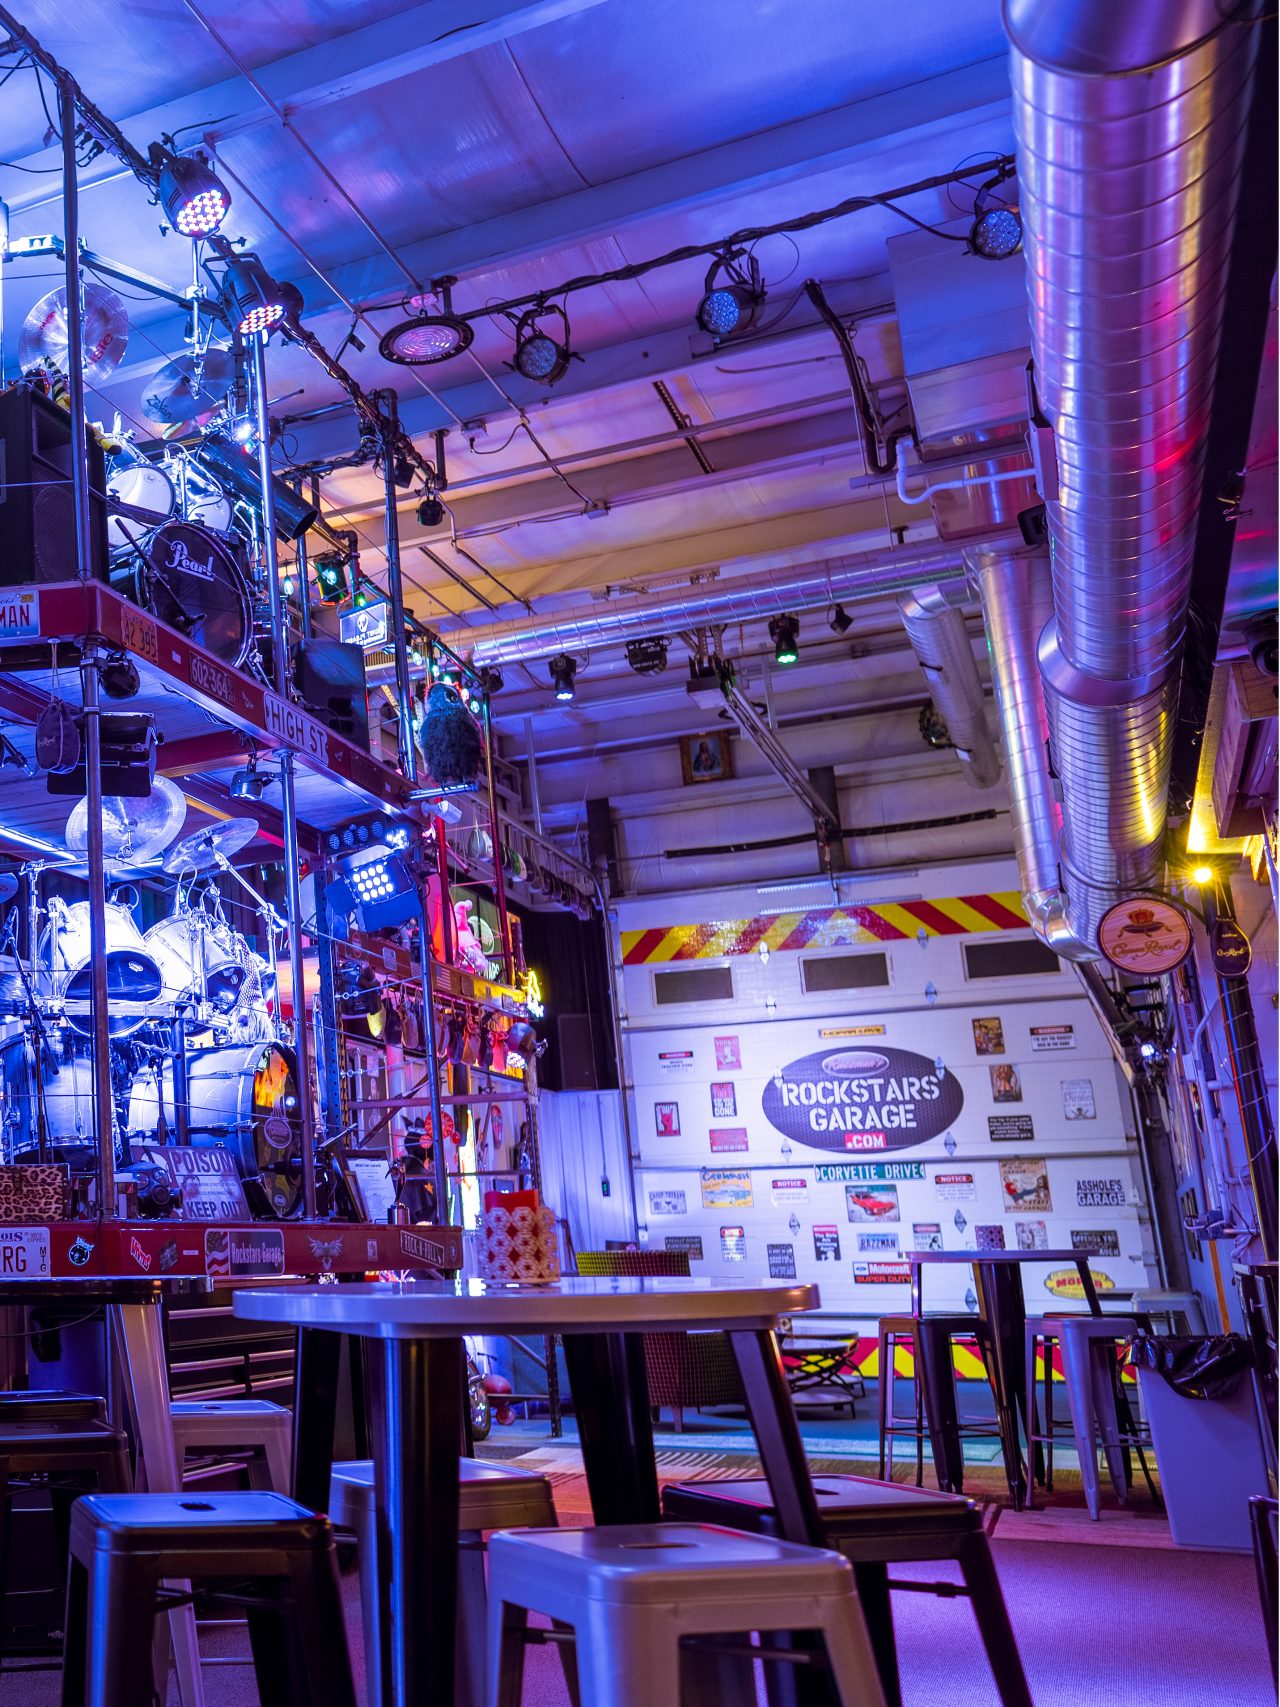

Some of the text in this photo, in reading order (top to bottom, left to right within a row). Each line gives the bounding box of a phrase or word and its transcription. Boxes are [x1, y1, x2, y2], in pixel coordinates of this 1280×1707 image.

[165, 540, 215, 581] Pearl
[192, 658, 228, 699] 602-364
[271, 700, 324, 757] HIGH ST
[782, 1075, 940, 1107] ROCKSTARS
[809, 1104, 917, 1131] GARAGE
[846, 1134, 884, 1148] .COM
[171, 1151, 234, 1173] POISON
[821, 1163, 920, 1181] CORVETTE DRIVE
[940, 1175, 967, 1183] NOTICE
[1077, 1179, 1123, 1192] ASSHOLE'S
[1078, 1193, 1125, 1206] GARAGE
[187, 1201, 217, 1218] KEEP
[861, 1237, 896, 1249] RAZZMAN
[232, 1242, 281, 1267] Rockstars Garage
[869, 1263, 911, 1275] Motorcraft
[856, 1275, 912, 1283] SUPER DUTY
